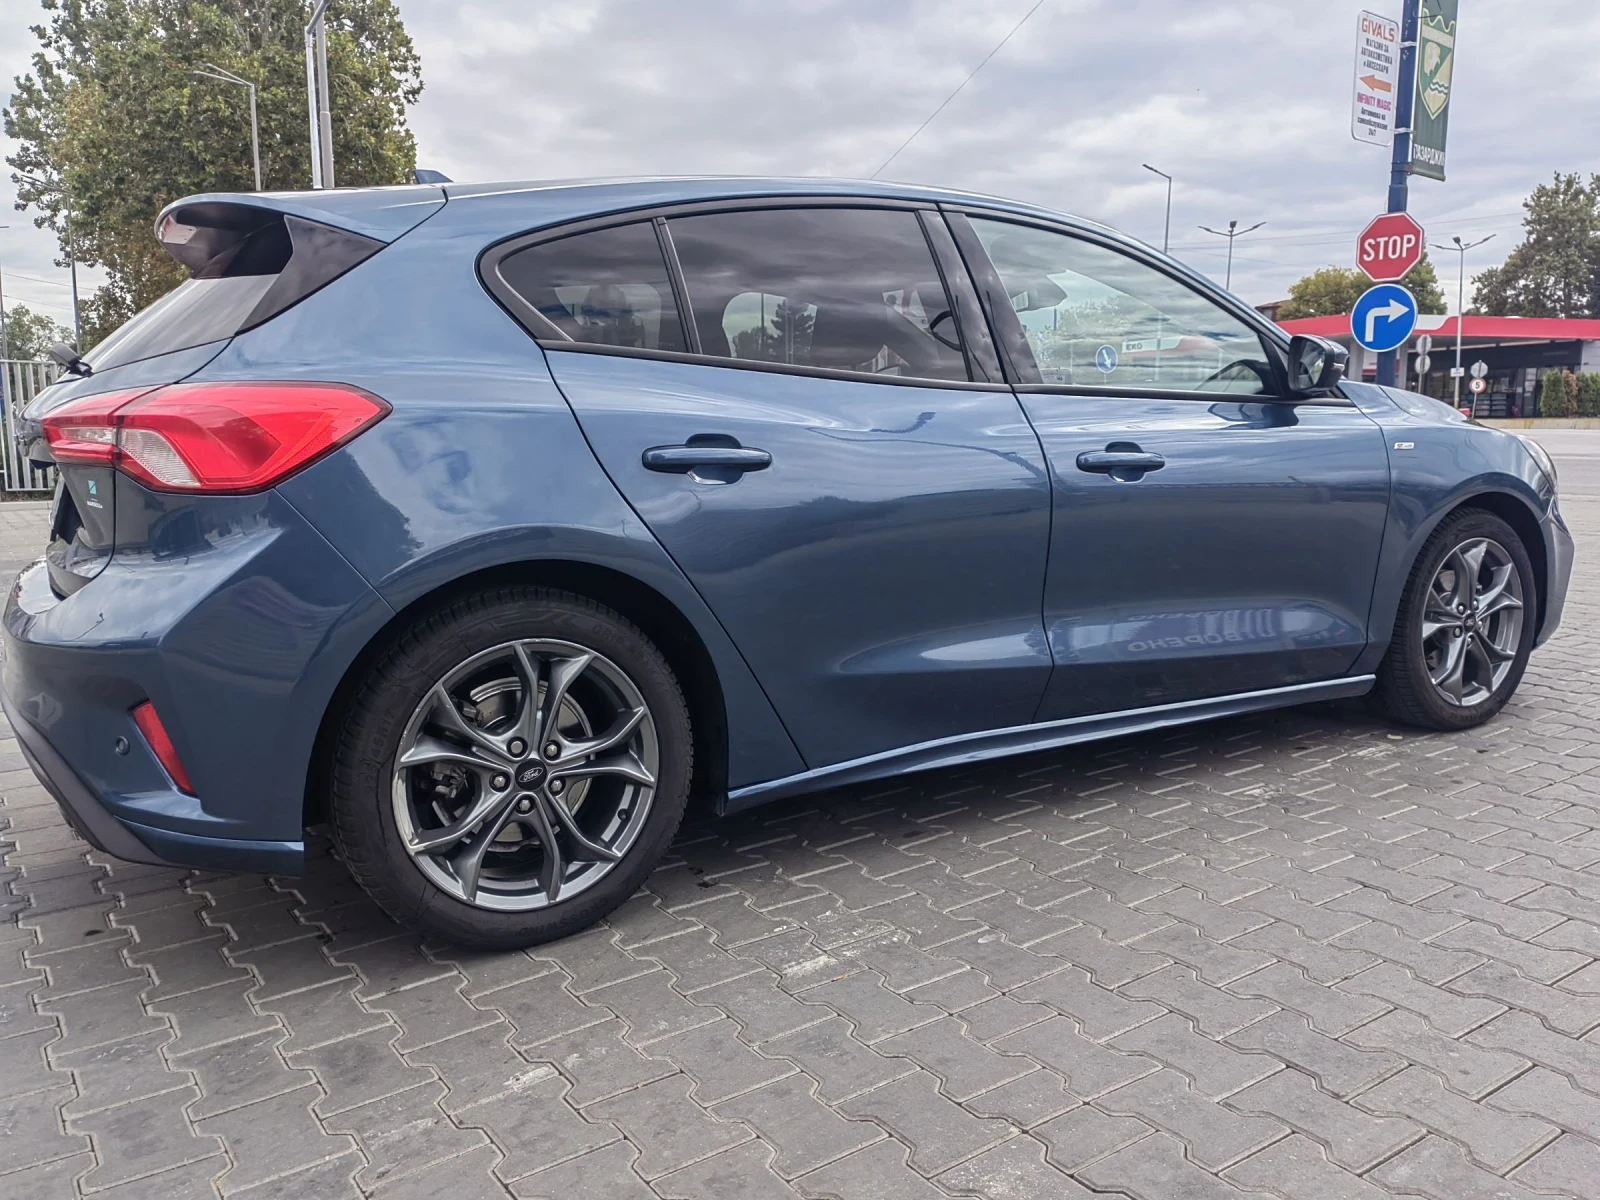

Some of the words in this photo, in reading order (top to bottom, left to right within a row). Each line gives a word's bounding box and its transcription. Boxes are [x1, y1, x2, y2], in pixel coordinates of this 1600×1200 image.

[1361, 18, 1395, 43] GIVALS
[1366, 37, 1384, 52] МАГАЗИН
[1357, 92, 1376, 107] INFINITY
[1376, 98, 1392, 111] MAGIC
[1413, 143, 1445, 166] ПАЗАРДЖИ
[1363, 233, 1416, 262] STOP
[1475, 381, 1480, 389] 5
